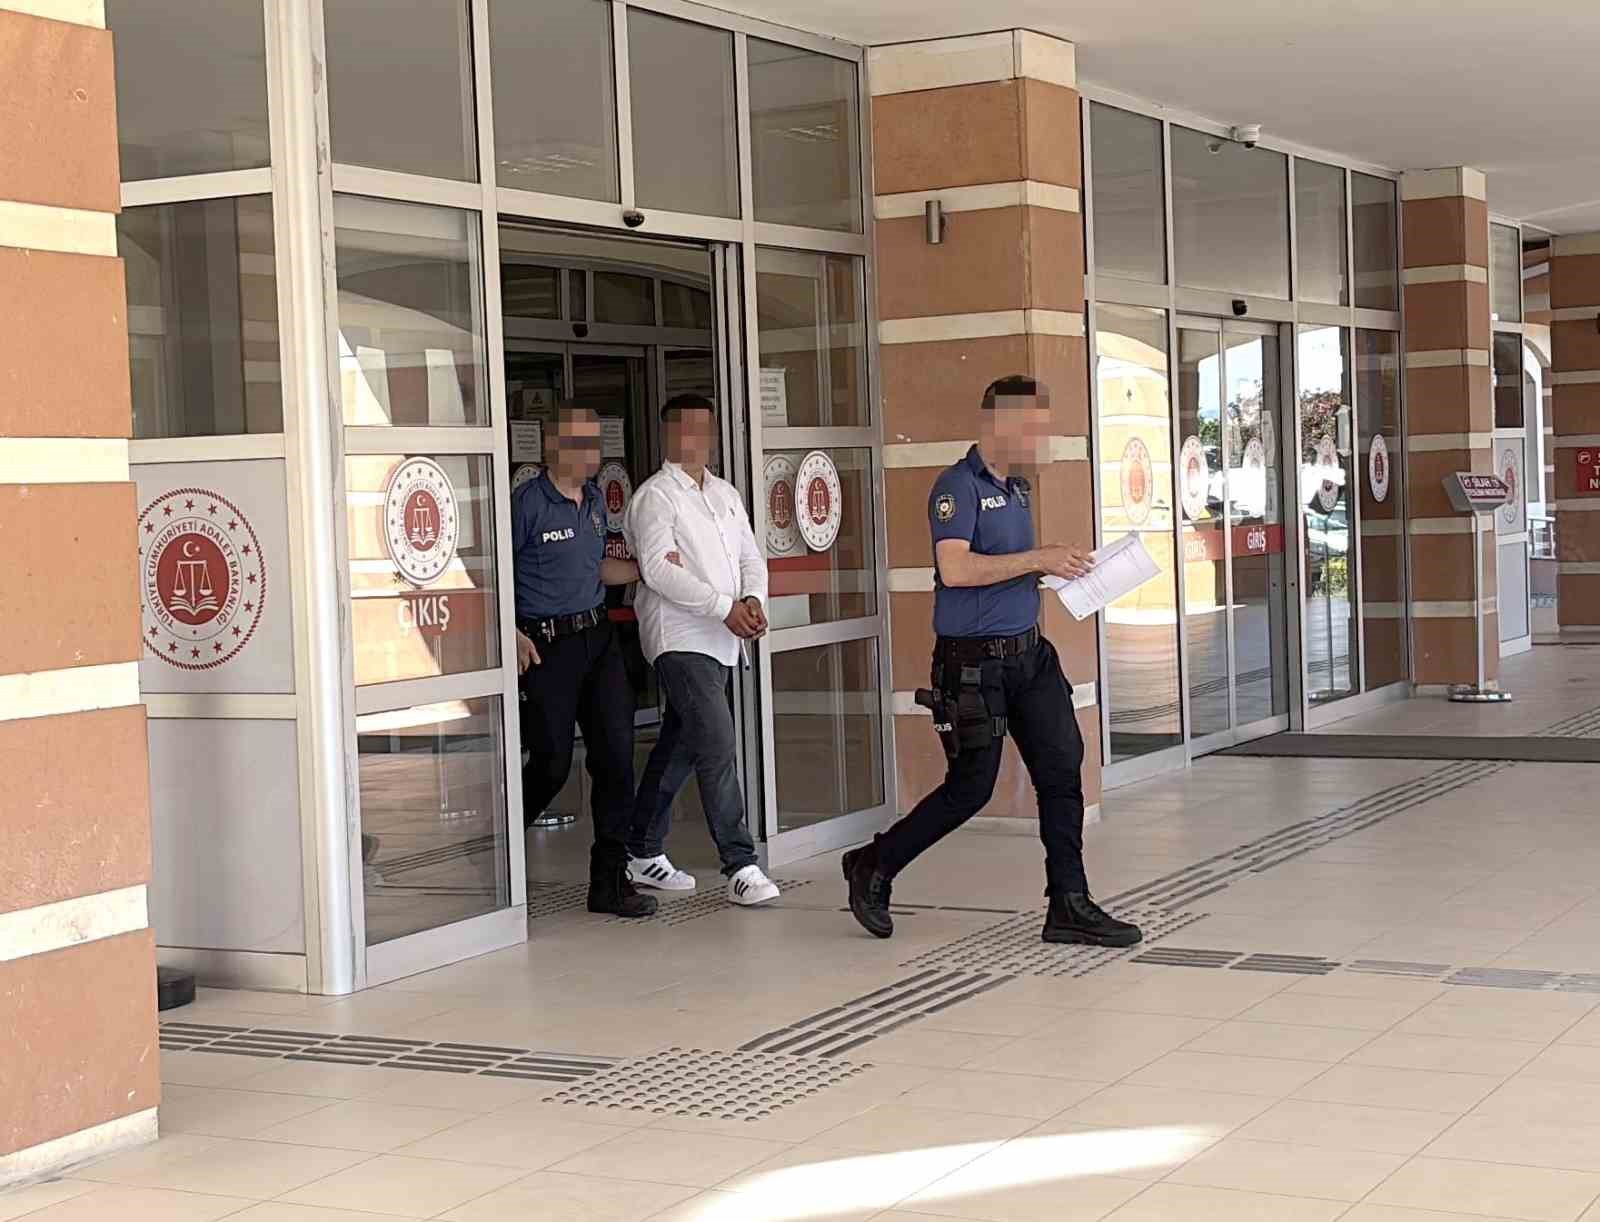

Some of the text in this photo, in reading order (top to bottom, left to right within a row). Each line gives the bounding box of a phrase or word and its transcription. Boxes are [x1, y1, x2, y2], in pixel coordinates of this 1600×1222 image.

[980, 495, 1007, 511] POLIS
[542, 528, 575, 543] POLIS
[1247, 527, 1266, 552] GİRİŞ
[148, 520, 240, 628] TÜRKİYE CUMHURİYETİ ADALET BAKANLIĞI
[398, 595, 450, 633] ÇIKIŞ
